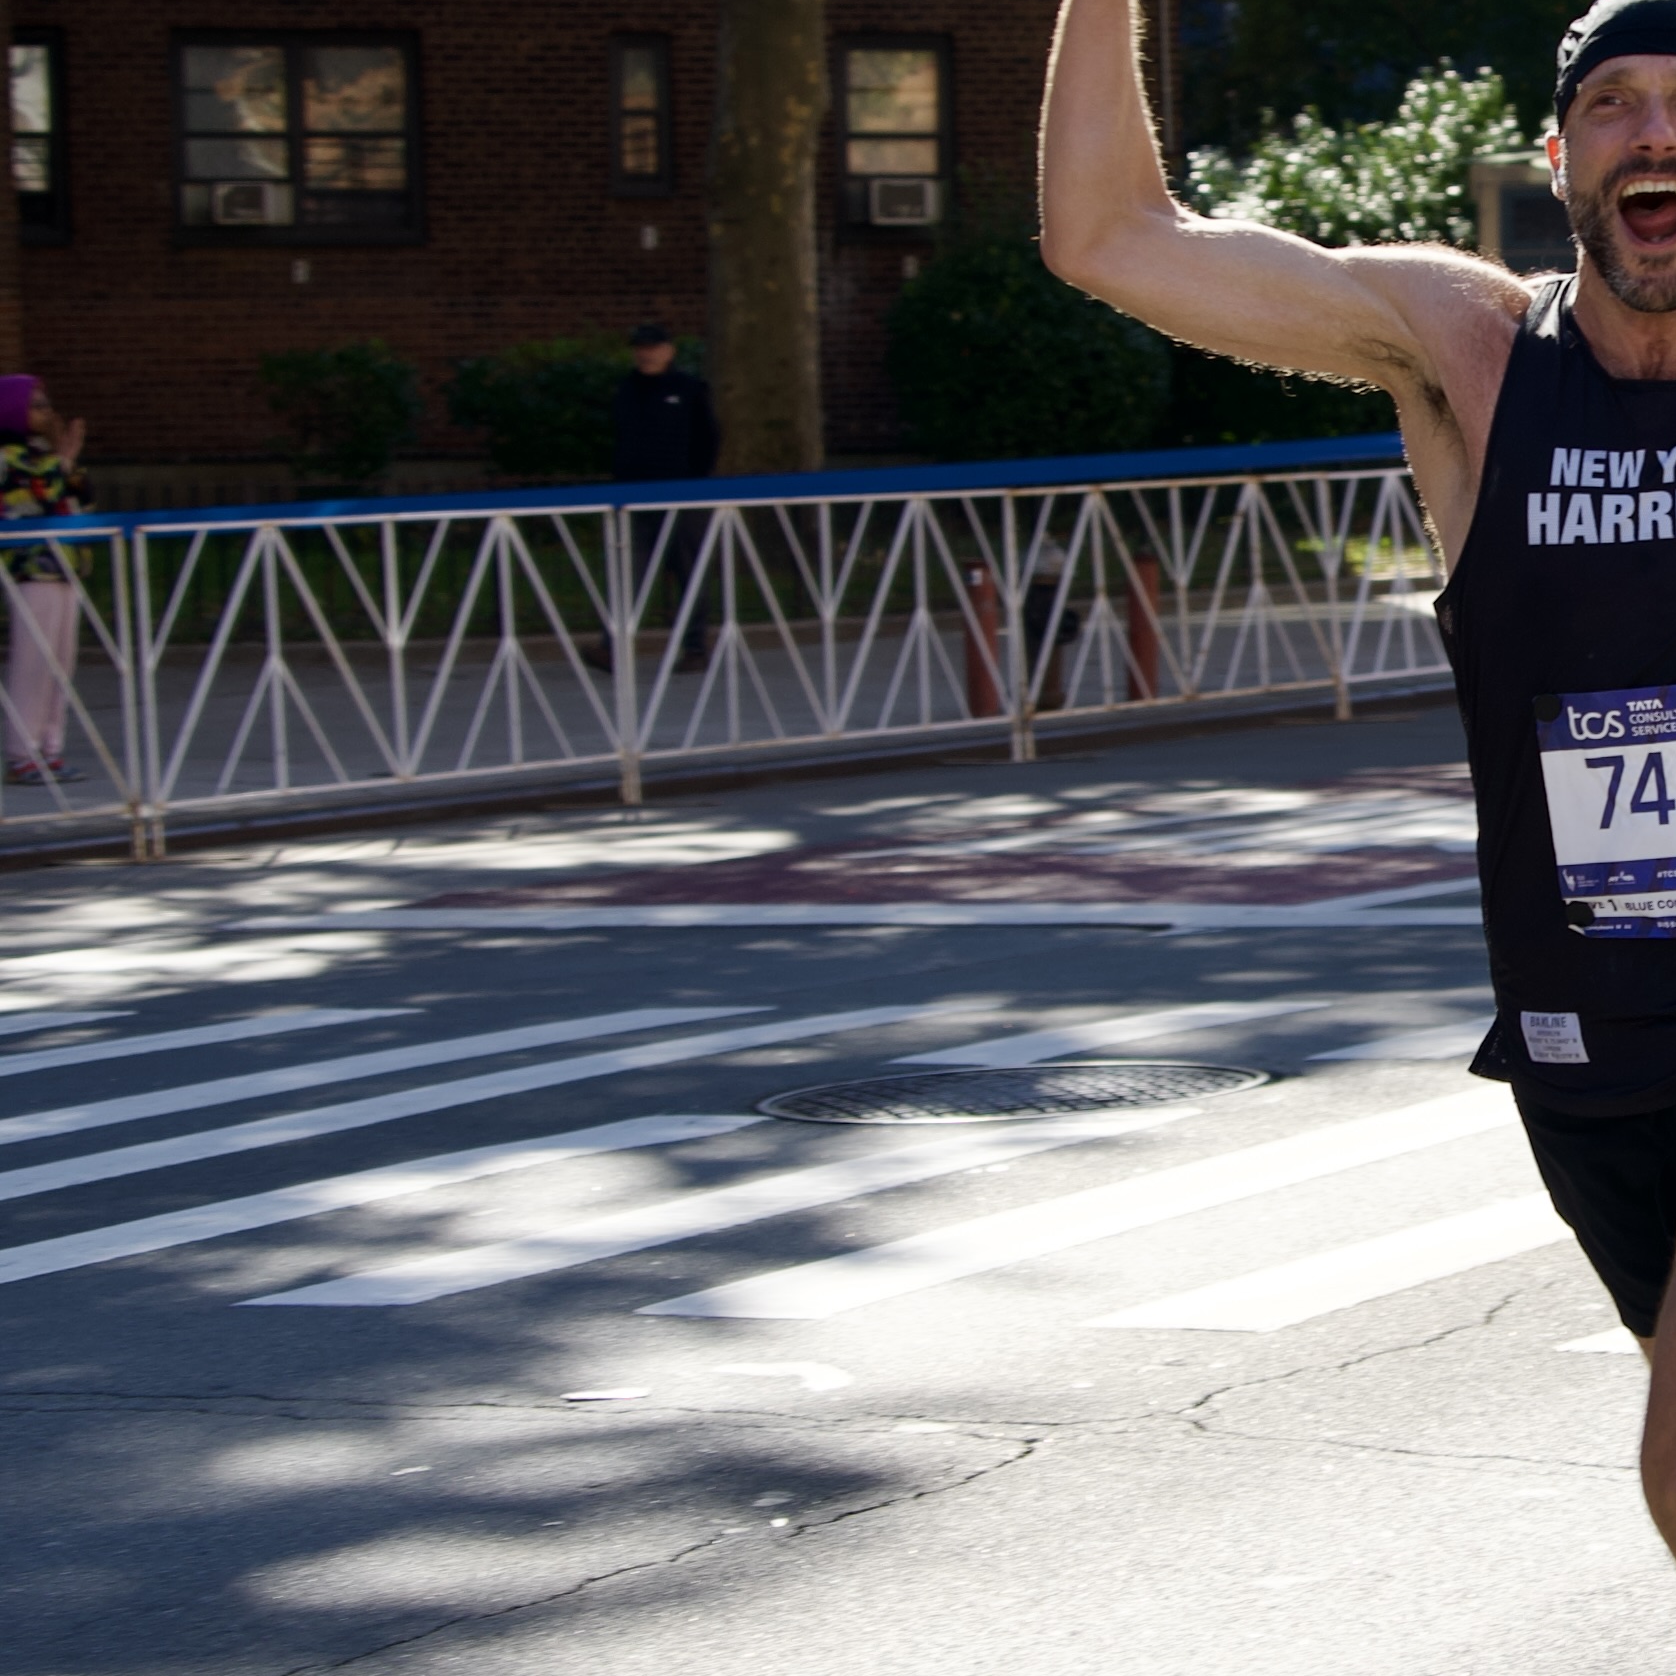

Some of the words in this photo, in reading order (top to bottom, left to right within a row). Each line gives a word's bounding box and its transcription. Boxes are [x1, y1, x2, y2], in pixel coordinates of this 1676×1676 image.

[1549, 447, 1646, 488] NEW
[1626, 699, 1663, 712] TATA
[1567, 706, 1625, 740] tcs
[1624, 900, 1654, 911] BLUE
